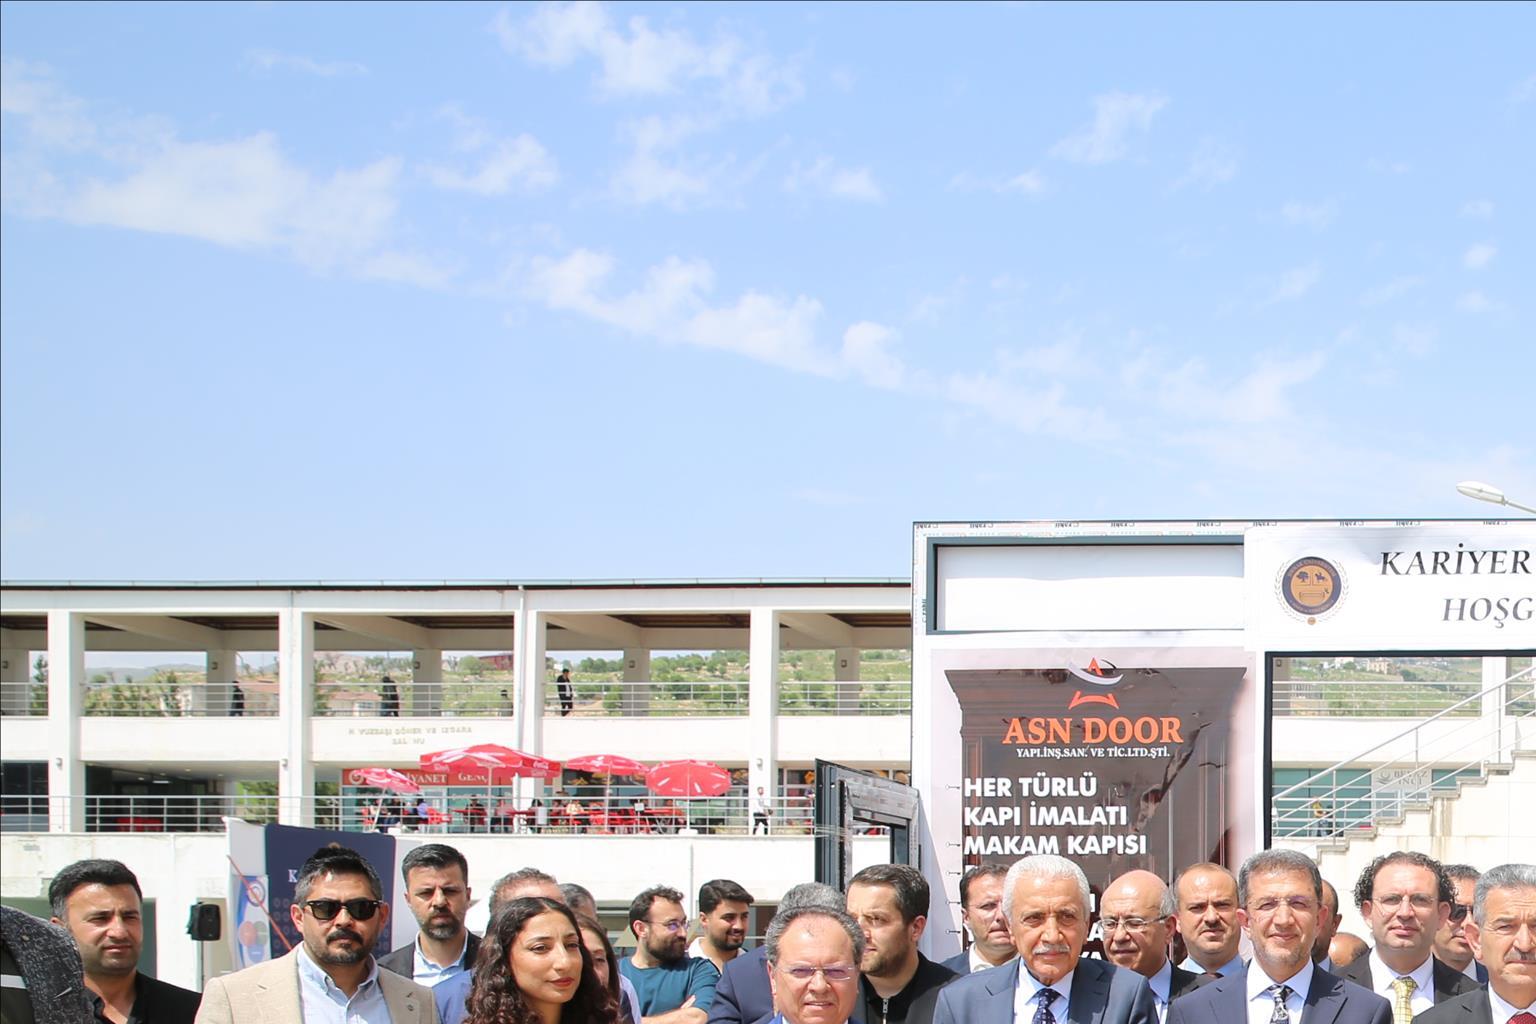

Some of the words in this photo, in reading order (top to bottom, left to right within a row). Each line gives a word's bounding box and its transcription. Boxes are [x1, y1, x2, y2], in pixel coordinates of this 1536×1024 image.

[1381, 543, 1531, 575] KARİYER
[1002, 717, 1073, 745] ASN
[1083, 716, 1184, 744] DOOR
[1091, 747, 1105, 758] VE
[964, 777, 1012, 797] HER
[1019, 772, 1097, 797] TÜRLÜ
[964, 806, 1021, 826] KAPI
[1029, 800, 1127, 826] İMALATI
[963, 835, 1060, 855] MAKAM
[1067, 835, 1147, 855] KAPISI
